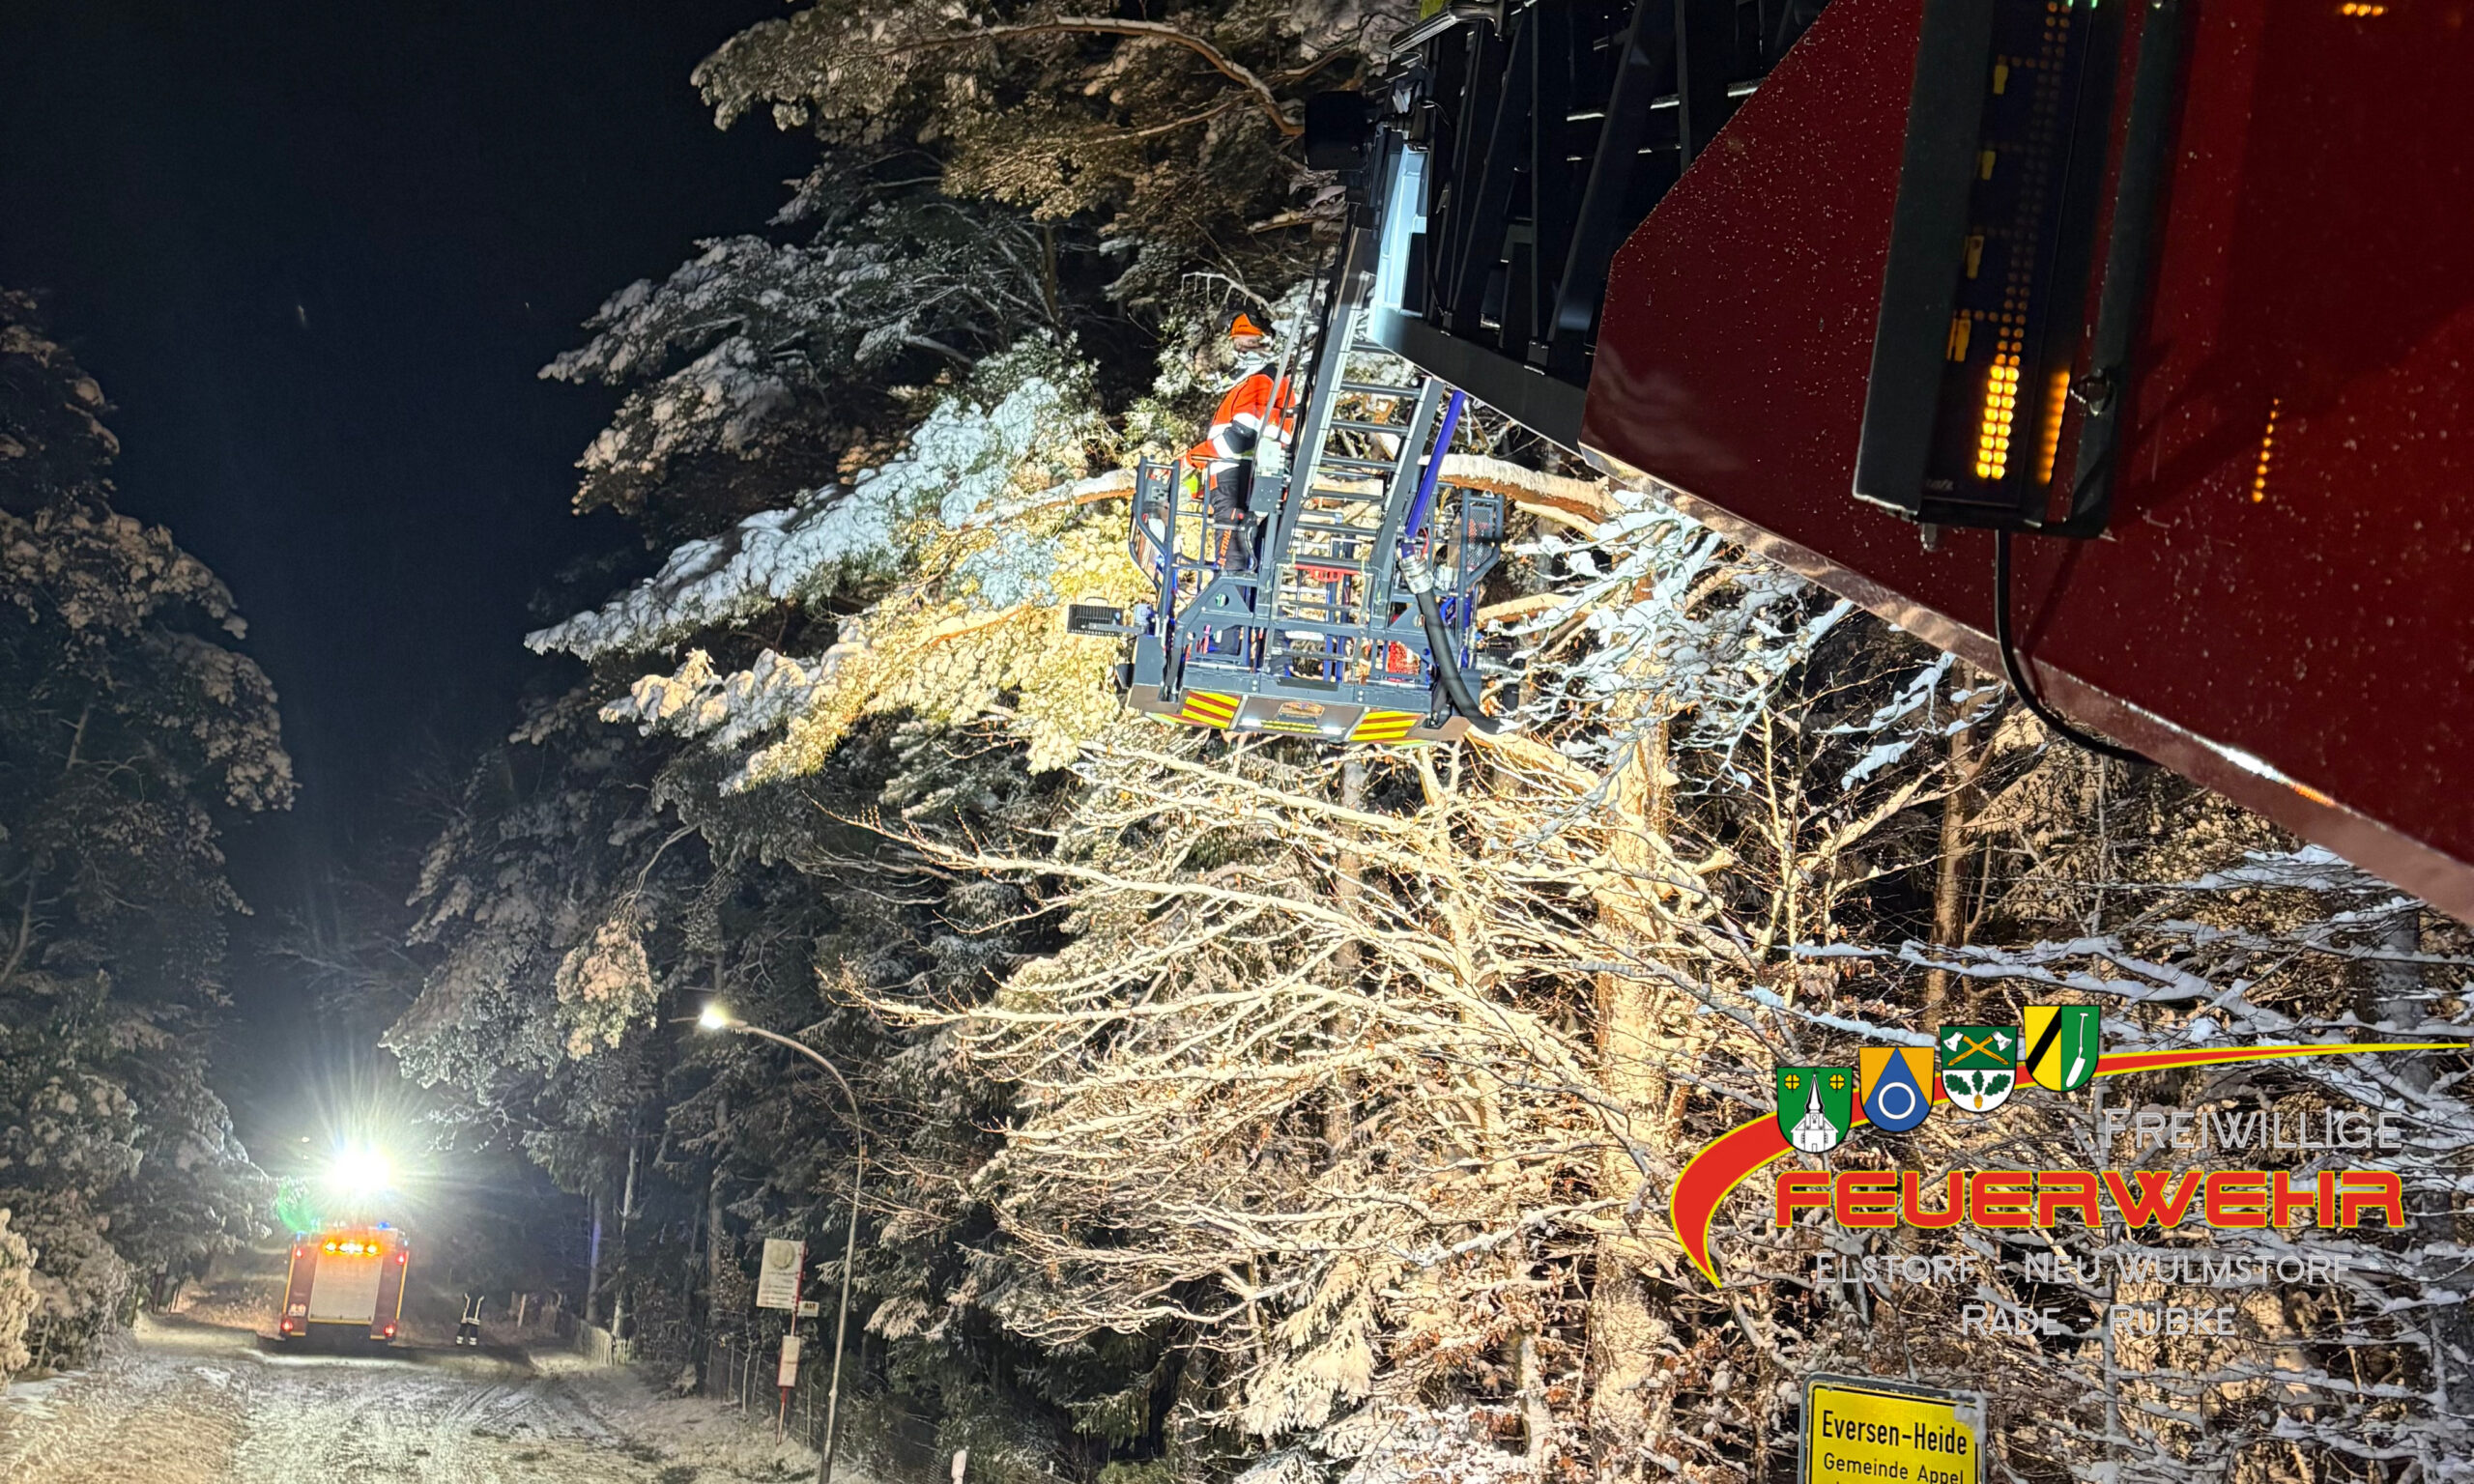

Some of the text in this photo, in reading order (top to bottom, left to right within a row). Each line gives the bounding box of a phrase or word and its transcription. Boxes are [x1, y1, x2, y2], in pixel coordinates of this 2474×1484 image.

[1220, 528, 1232, 557] STIHL
[1823, 1410, 1967, 1455] Eversen-Heide
[1824, 1452, 1964, 1484] Gemeinde Appel
